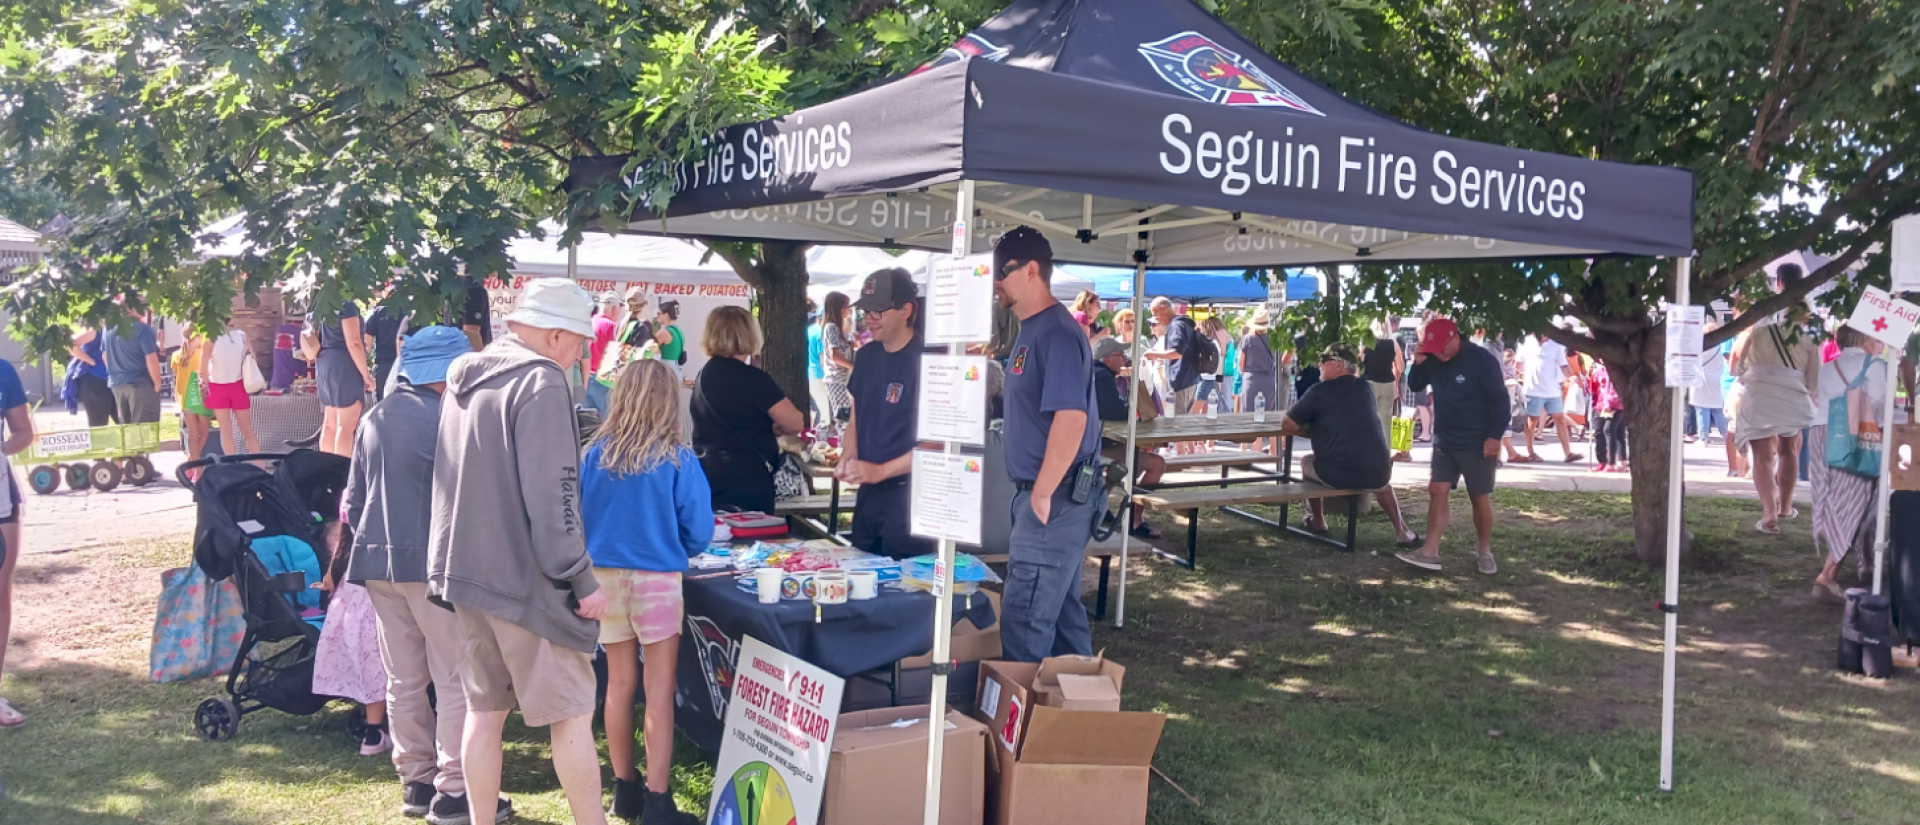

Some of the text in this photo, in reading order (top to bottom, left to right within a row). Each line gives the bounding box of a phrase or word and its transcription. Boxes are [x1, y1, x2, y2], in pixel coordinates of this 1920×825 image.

[741, 115, 851, 181] Services
[1159, 112, 1587, 221] Seguin Fire Services
[490, 295, 516, 307] your
[653, 282, 695, 295] BAKED
[699, 284, 748, 297] POTATOES
[1862, 290, 1918, 323] First Aid
[41, 433, 88, 446] ROSSEAU
[560, 466, 579, 536] Hawaii
[752, 657, 785, 682] EMERGENCIES
[736, 673, 770, 711] FOREST
[769, 690, 791, 722] FIRE
[789, 702, 830, 743] HAZARD
[744, 707, 810, 752] FOR SEGUIN TOWNSHIP
[768, 749, 775, 758] or
